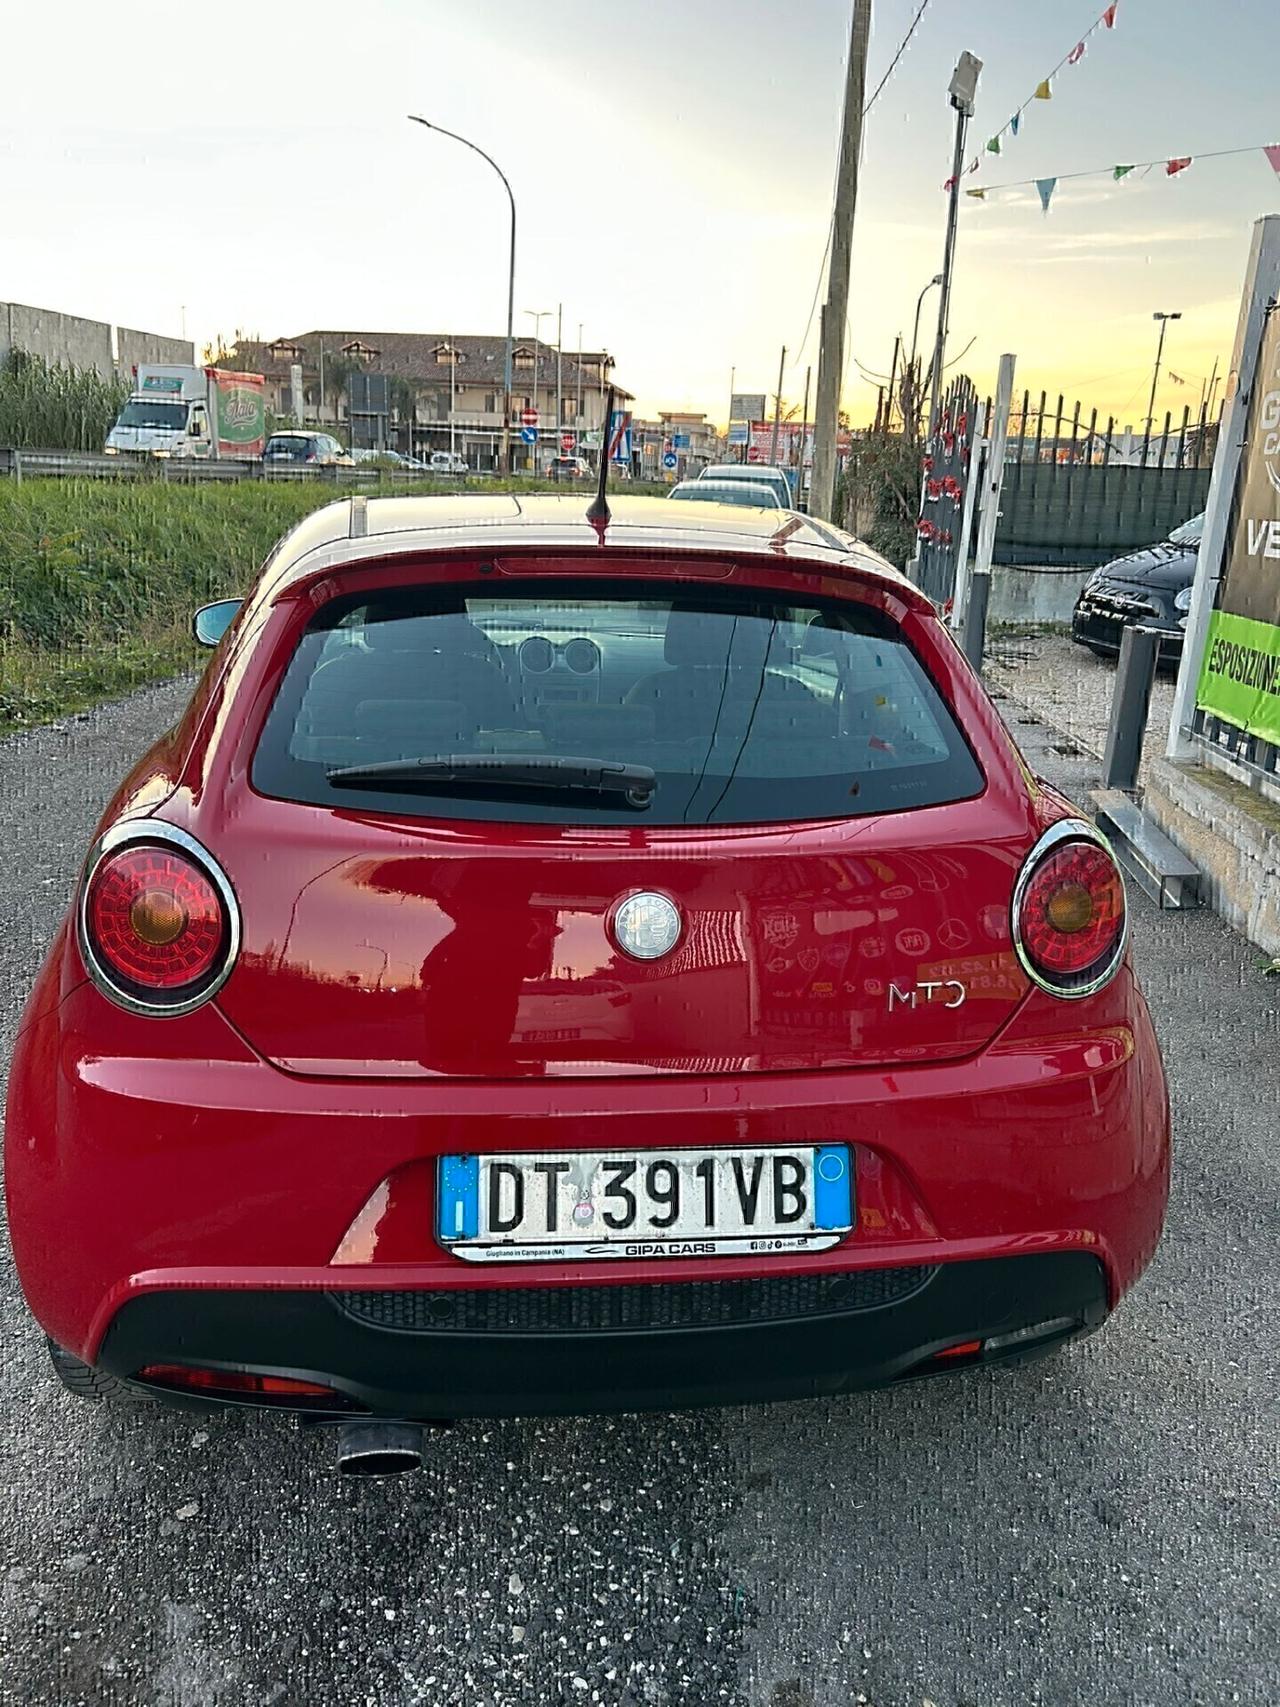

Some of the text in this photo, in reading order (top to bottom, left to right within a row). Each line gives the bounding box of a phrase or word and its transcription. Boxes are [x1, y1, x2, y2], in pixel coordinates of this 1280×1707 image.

[488, 1155, 807, 1232] DT 391VB
[486, 1250, 513, 1258] Giugliano
[522, 1249, 550, 1257] Campania
[552, 1248, 565, 1256] (NA)
[625, 1242, 716, 1256] GIPA CARS
